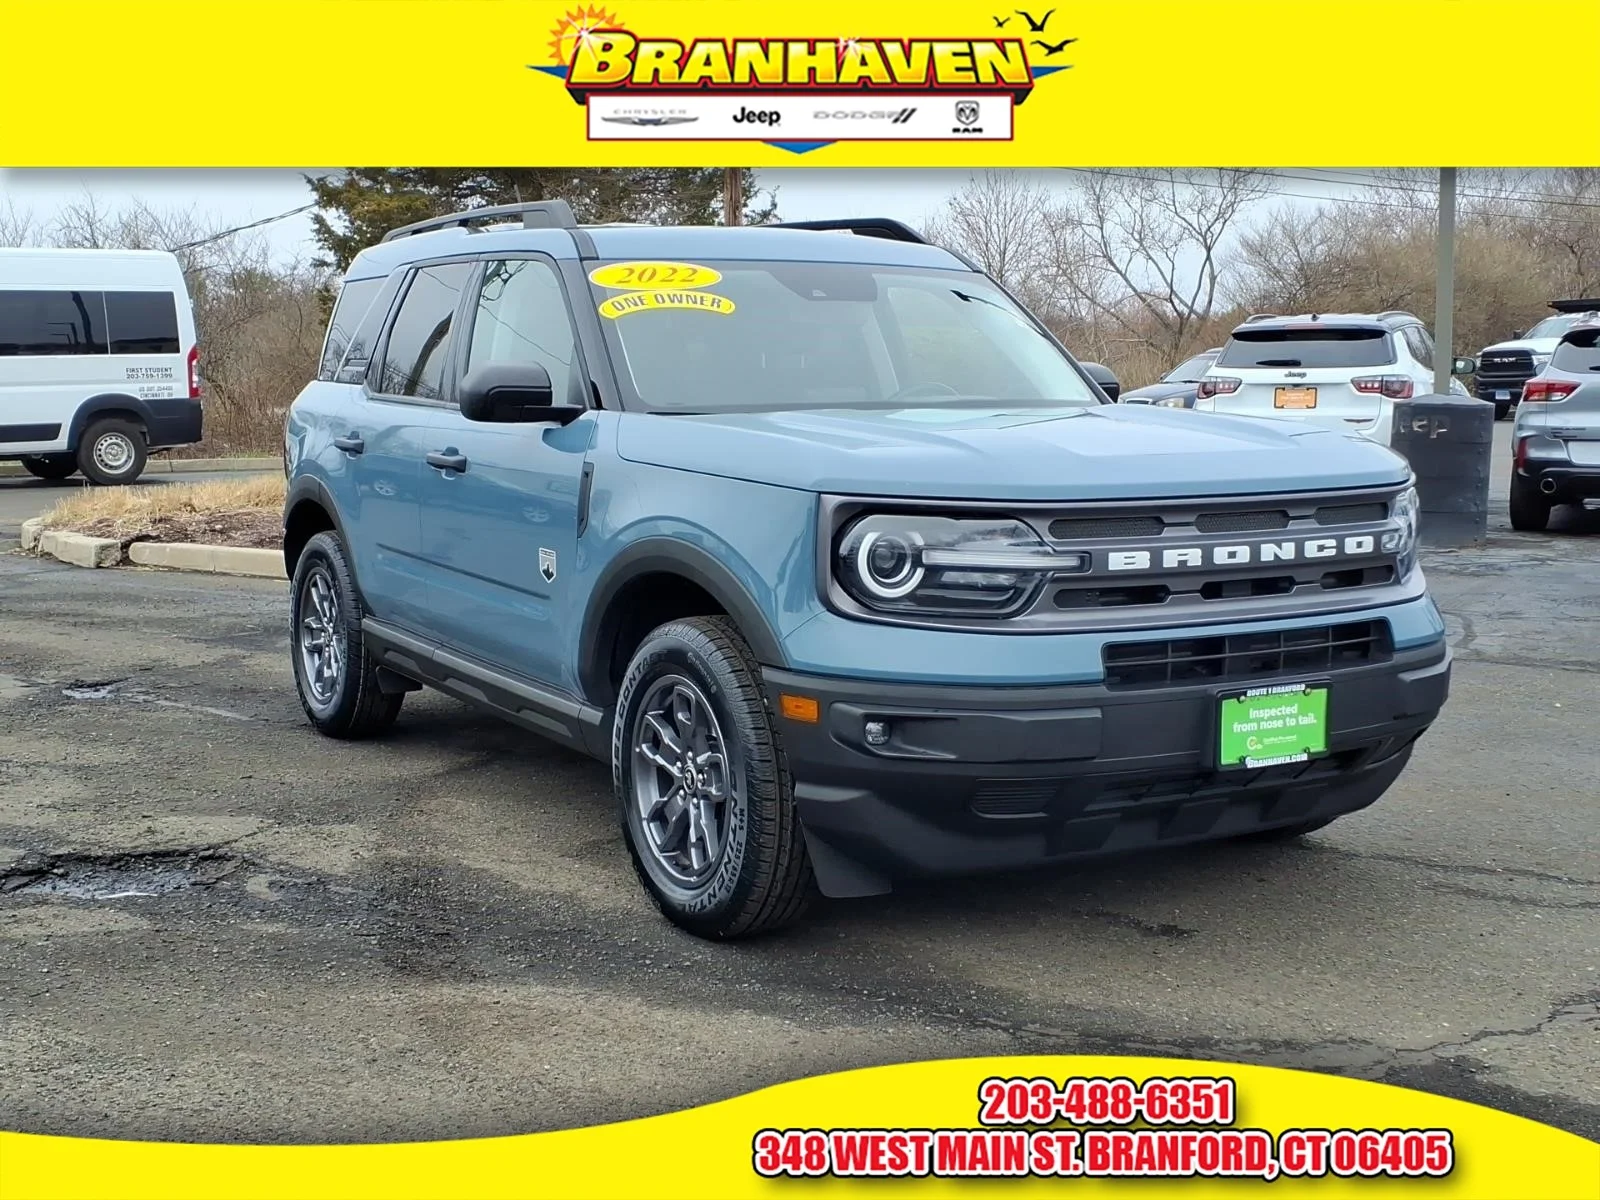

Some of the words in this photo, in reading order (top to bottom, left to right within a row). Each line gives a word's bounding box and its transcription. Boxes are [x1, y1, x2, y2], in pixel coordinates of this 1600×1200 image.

[615, 267, 699, 284] 2022
[611, 295, 649, 312] ONE
[654, 293, 722, 309] OWNER
[1107, 535, 1374, 571] BRONCO
[1246, 688, 1268, 697] ROUTE
[1272, 683, 1306, 694] BRANFORD
[1249, 704, 1298, 719] Inspected
[1233, 721, 1257, 733] from
[1260, 719, 1283, 730] nose
[1286, 715, 1296, 726] to
[1299, 712, 1317, 725] tail.
